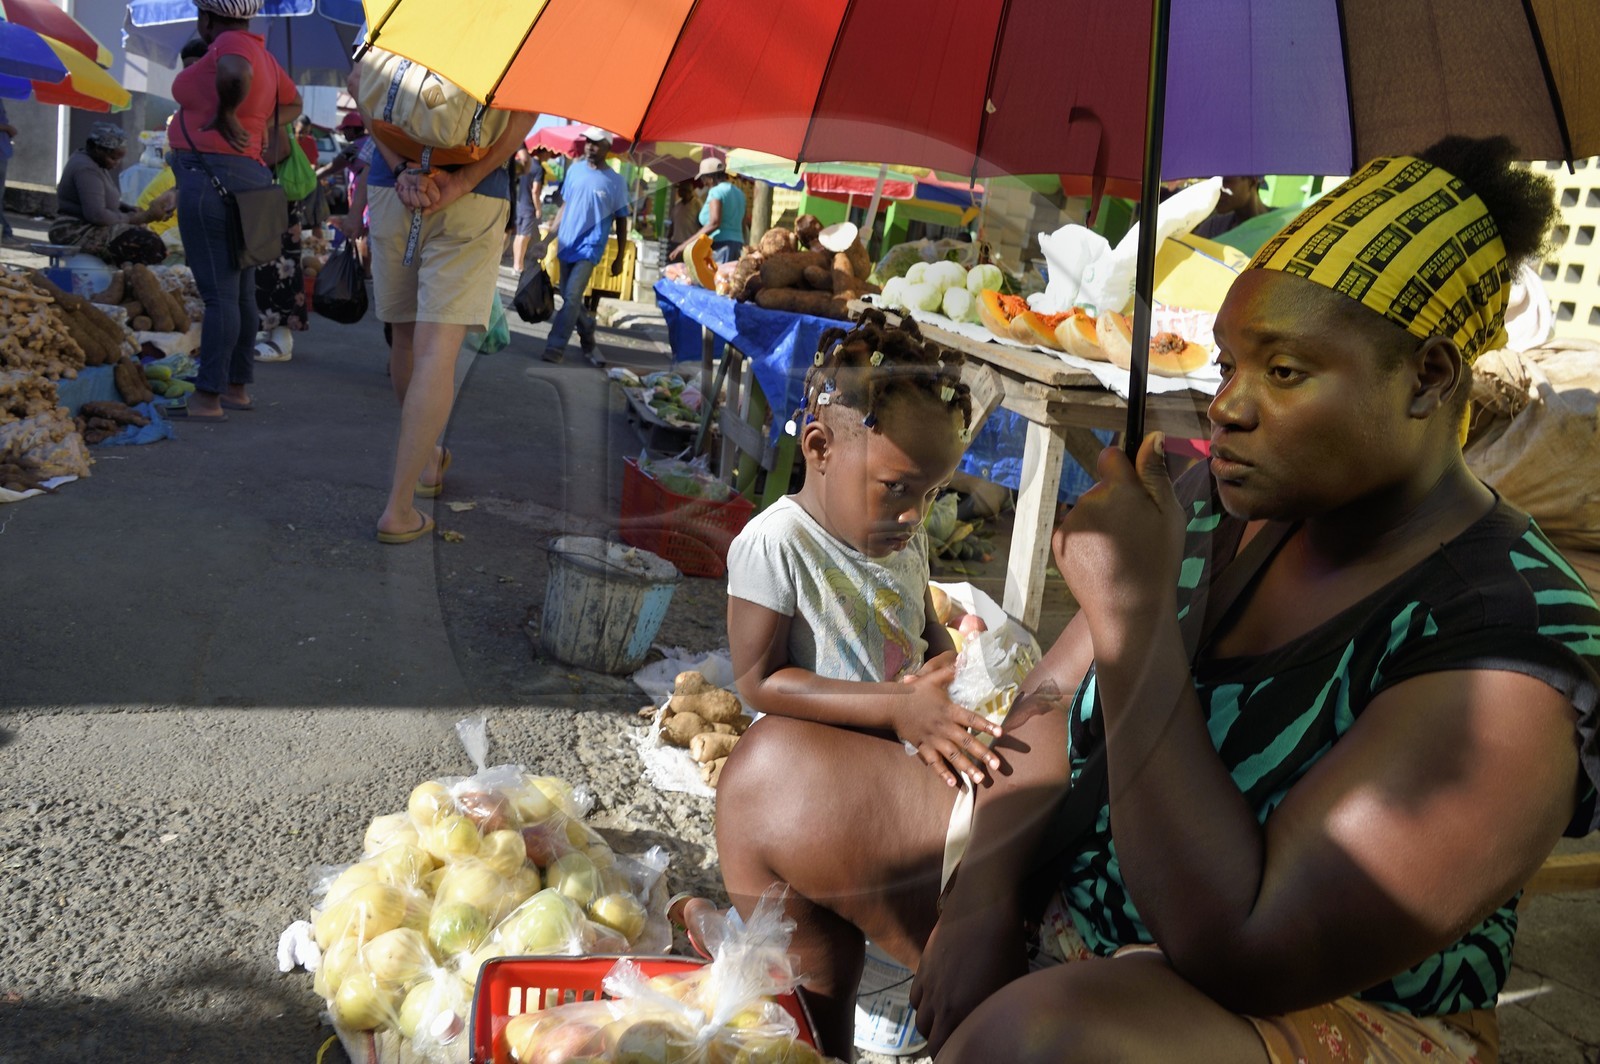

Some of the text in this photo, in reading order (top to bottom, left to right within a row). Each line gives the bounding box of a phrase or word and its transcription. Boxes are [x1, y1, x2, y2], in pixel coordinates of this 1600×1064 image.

[1398, 195, 1440, 225] WESTERN
[1418, 202, 1448, 223] UNION
[1360, 230, 1393, 263] WESTERN
[1376, 237, 1402, 262] UNION
[1421, 245, 1453, 279] WESTERN
[1436, 253, 1461, 279] UNION
